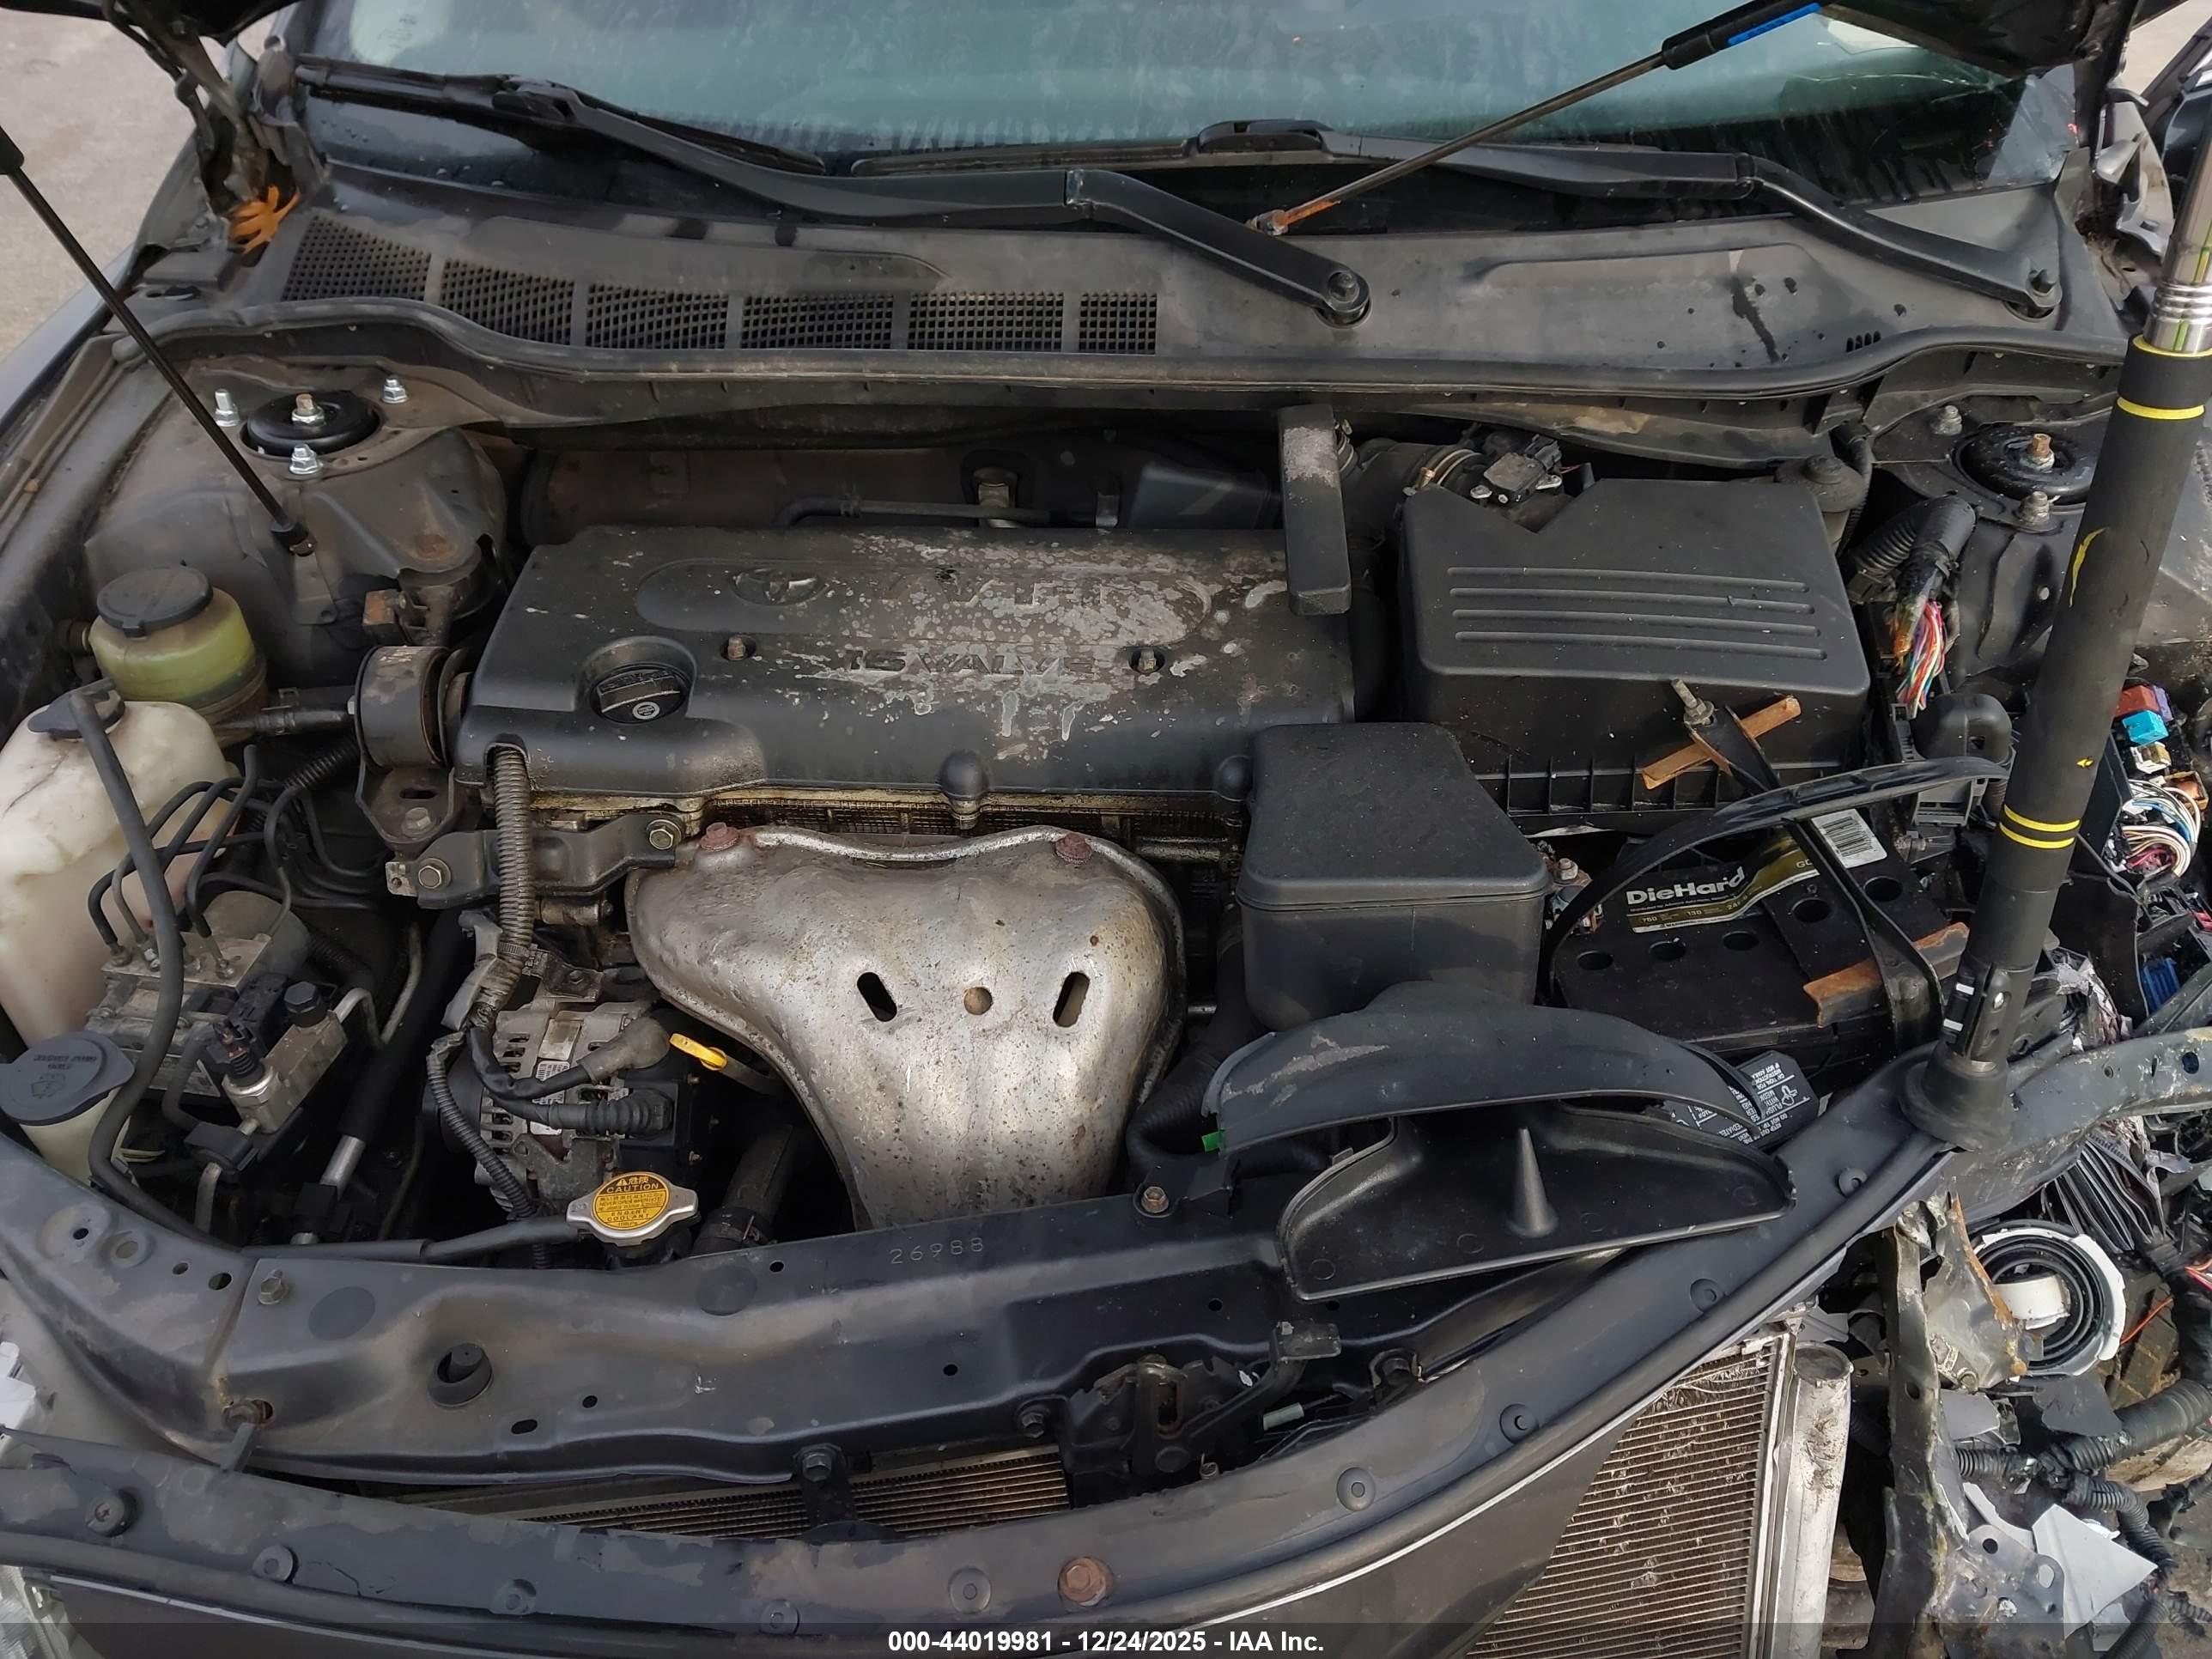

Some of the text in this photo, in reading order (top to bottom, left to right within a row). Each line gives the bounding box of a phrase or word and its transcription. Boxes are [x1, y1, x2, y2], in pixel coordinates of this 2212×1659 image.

[1626, 866, 1746, 905] DieHard
[606, 1182, 659, 1194] CAUTION
[606, 1213, 649, 1222] COOLANT
[611, 1208, 647, 1217] ENGINE
[889, 1237, 984, 1265] 26988
